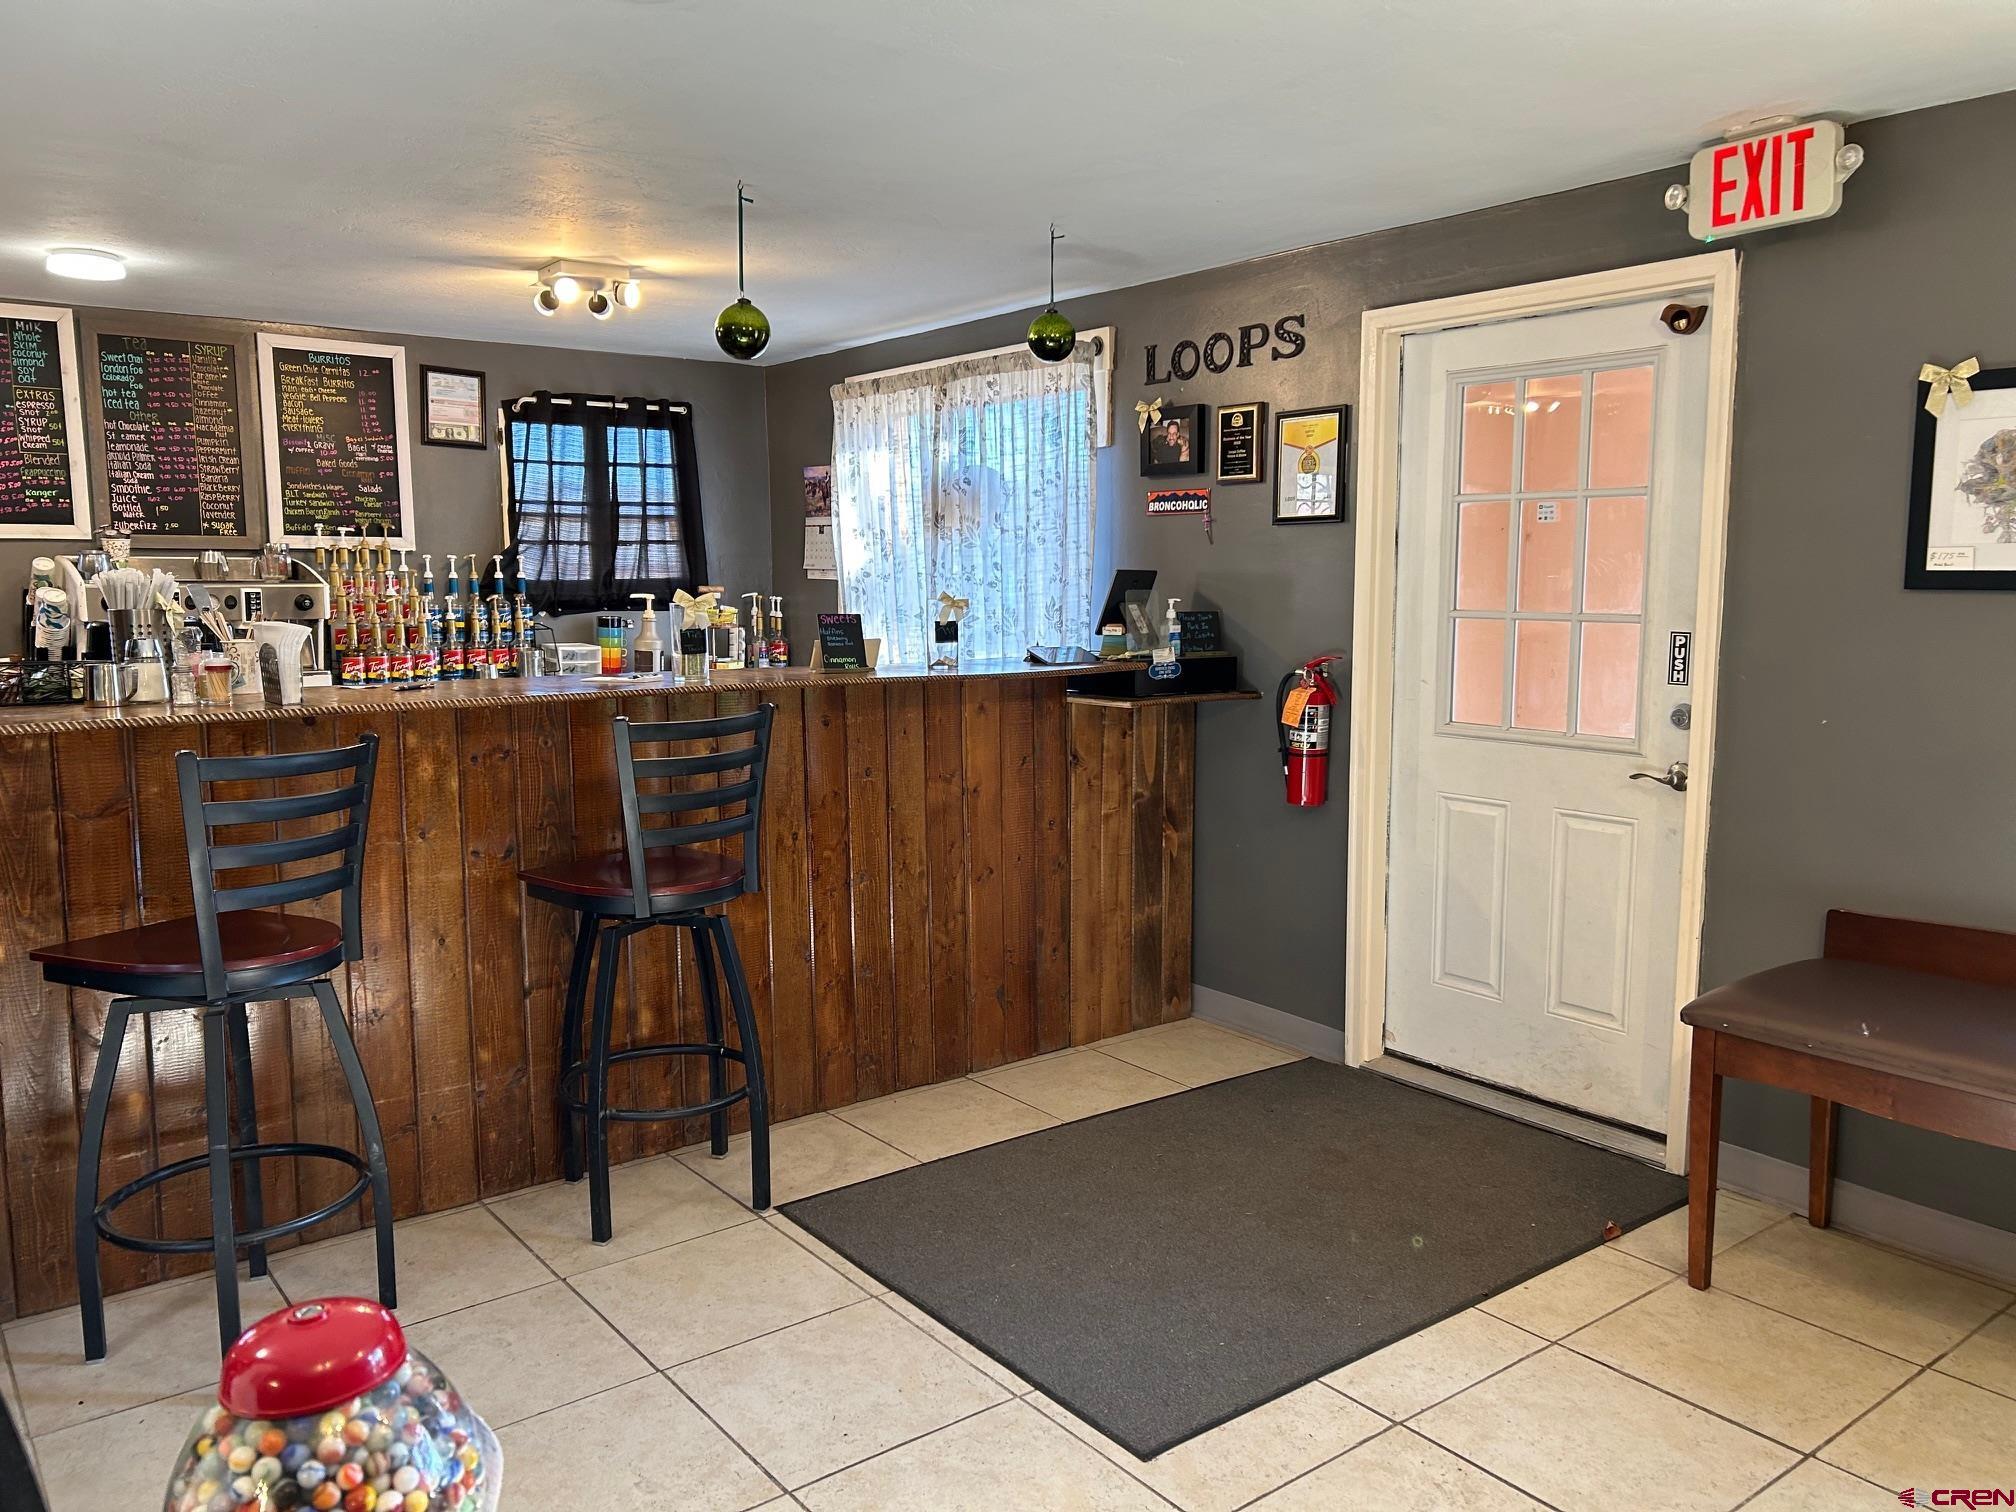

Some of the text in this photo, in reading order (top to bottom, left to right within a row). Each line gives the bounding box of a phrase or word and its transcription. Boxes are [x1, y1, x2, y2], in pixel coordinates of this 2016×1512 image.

[1712, 127, 1815, 228] EXIT
[13, 331, 42, 342] Whole
[121, 337, 147, 351] Tea
[194, 344, 228, 358] SYRUP
[1144, 314, 1306, 386] LOOPS
[12, 357, 45, 367] almond
[100, 351, 126, 362] Sweet
[127, 353, 143, 364] Chai
[120, 388, 136, 398] tea
[125, 398, 140, 410] tea
[194, 397, 228, 407] Cinnamon
[283, 400, 304, 409] Bacon
[18, 416, 48, 427] SYRUP
[195, 415, 224, 425] almond
[118, 420, 151, 432] Chocolate
[23, 453, 60, 466] Blended
[338, 458, 358, 468] Goods
[134, 461, 152, 471] Soda
[200, 474, 229, 483] Banana
[111, 483, 153, 495] Smoothie
[358, 484, 383, 493] Salads
[111, 493, 138, 503] Juice
[112, 502, 142, 512] Bottled
[202, 501, 234, 510] Coconut
[1148, 499, 1208, 511] BRONCOHOLIC
[285, 523, 312, 532] Buffalo
[1672, 635, 1686, 682] PUSH
